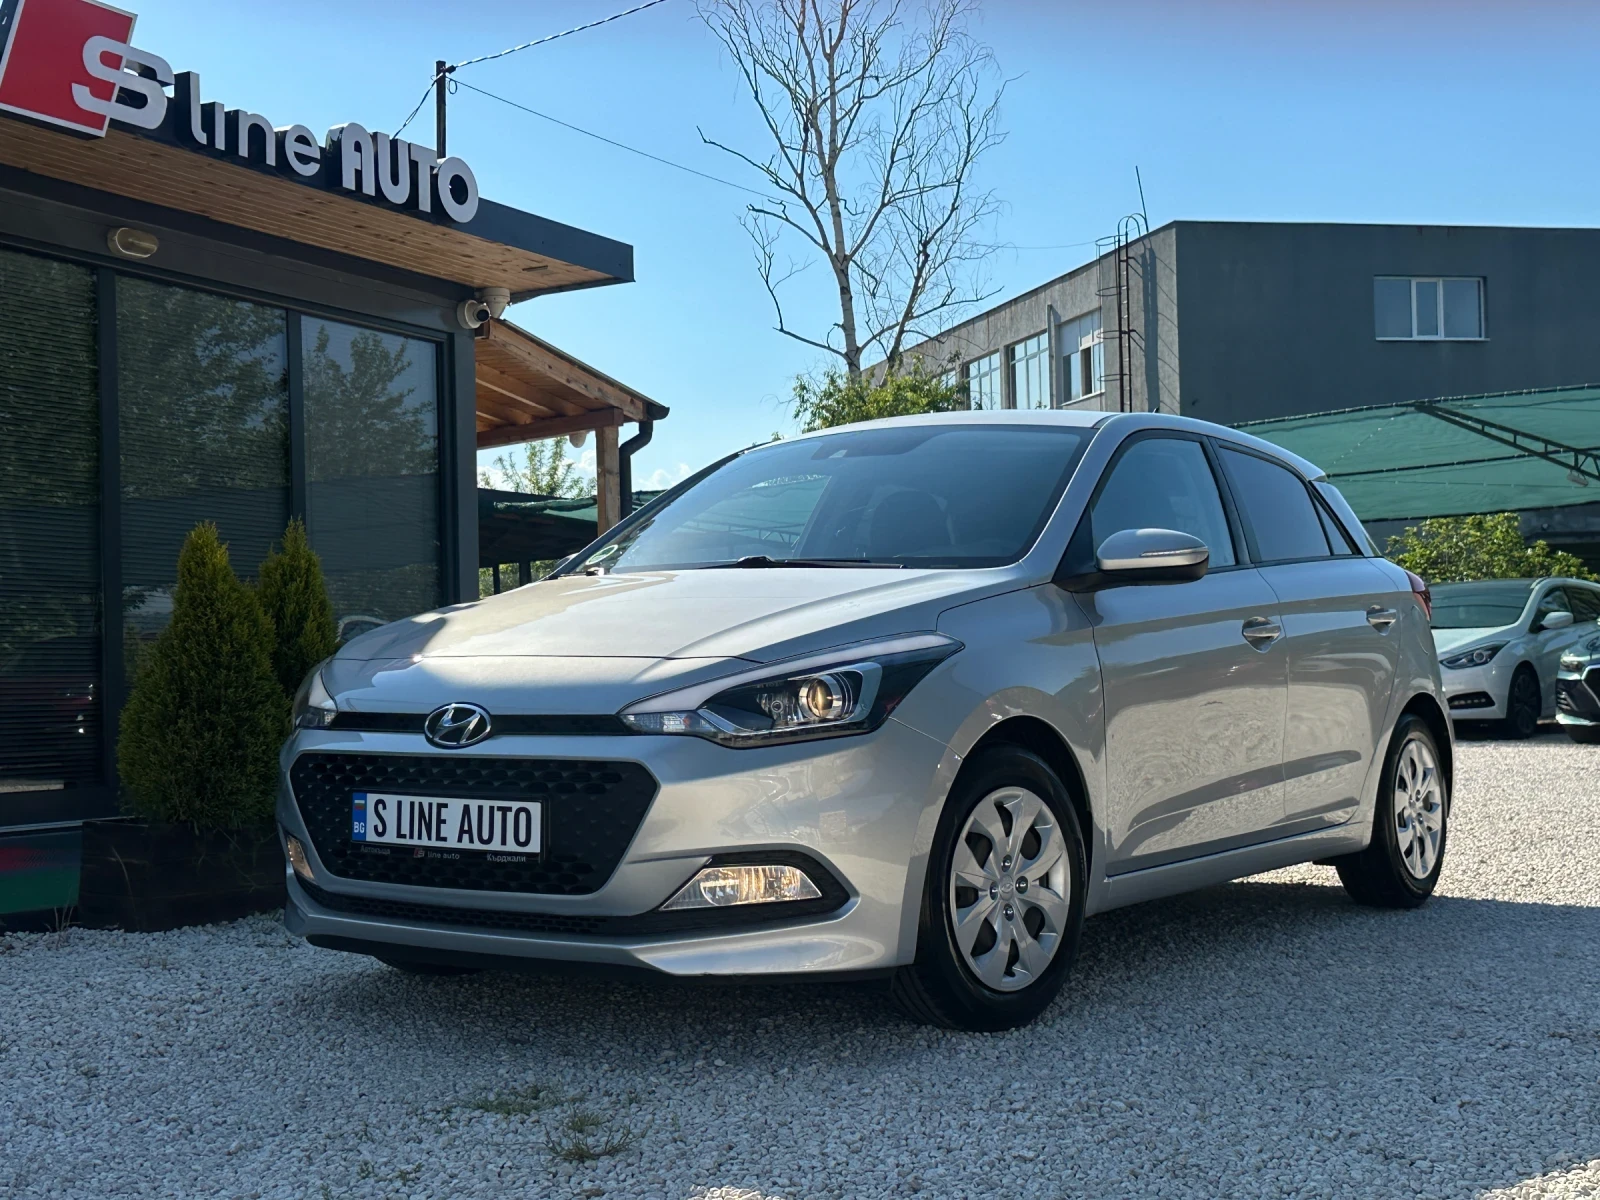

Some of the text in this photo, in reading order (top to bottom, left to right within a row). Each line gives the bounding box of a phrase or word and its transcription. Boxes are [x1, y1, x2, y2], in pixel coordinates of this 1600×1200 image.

[71, 35, 175, 130] S
[341, 122, 479, 224] AUTO
[353, 821, 365, 834] BG
[373, 798, 532, 848] S LINE AUTO
[427, 850, 442, 859] line
[442, 852, 460, 860] auto
[486, 853, 526, 863] Кърджали
